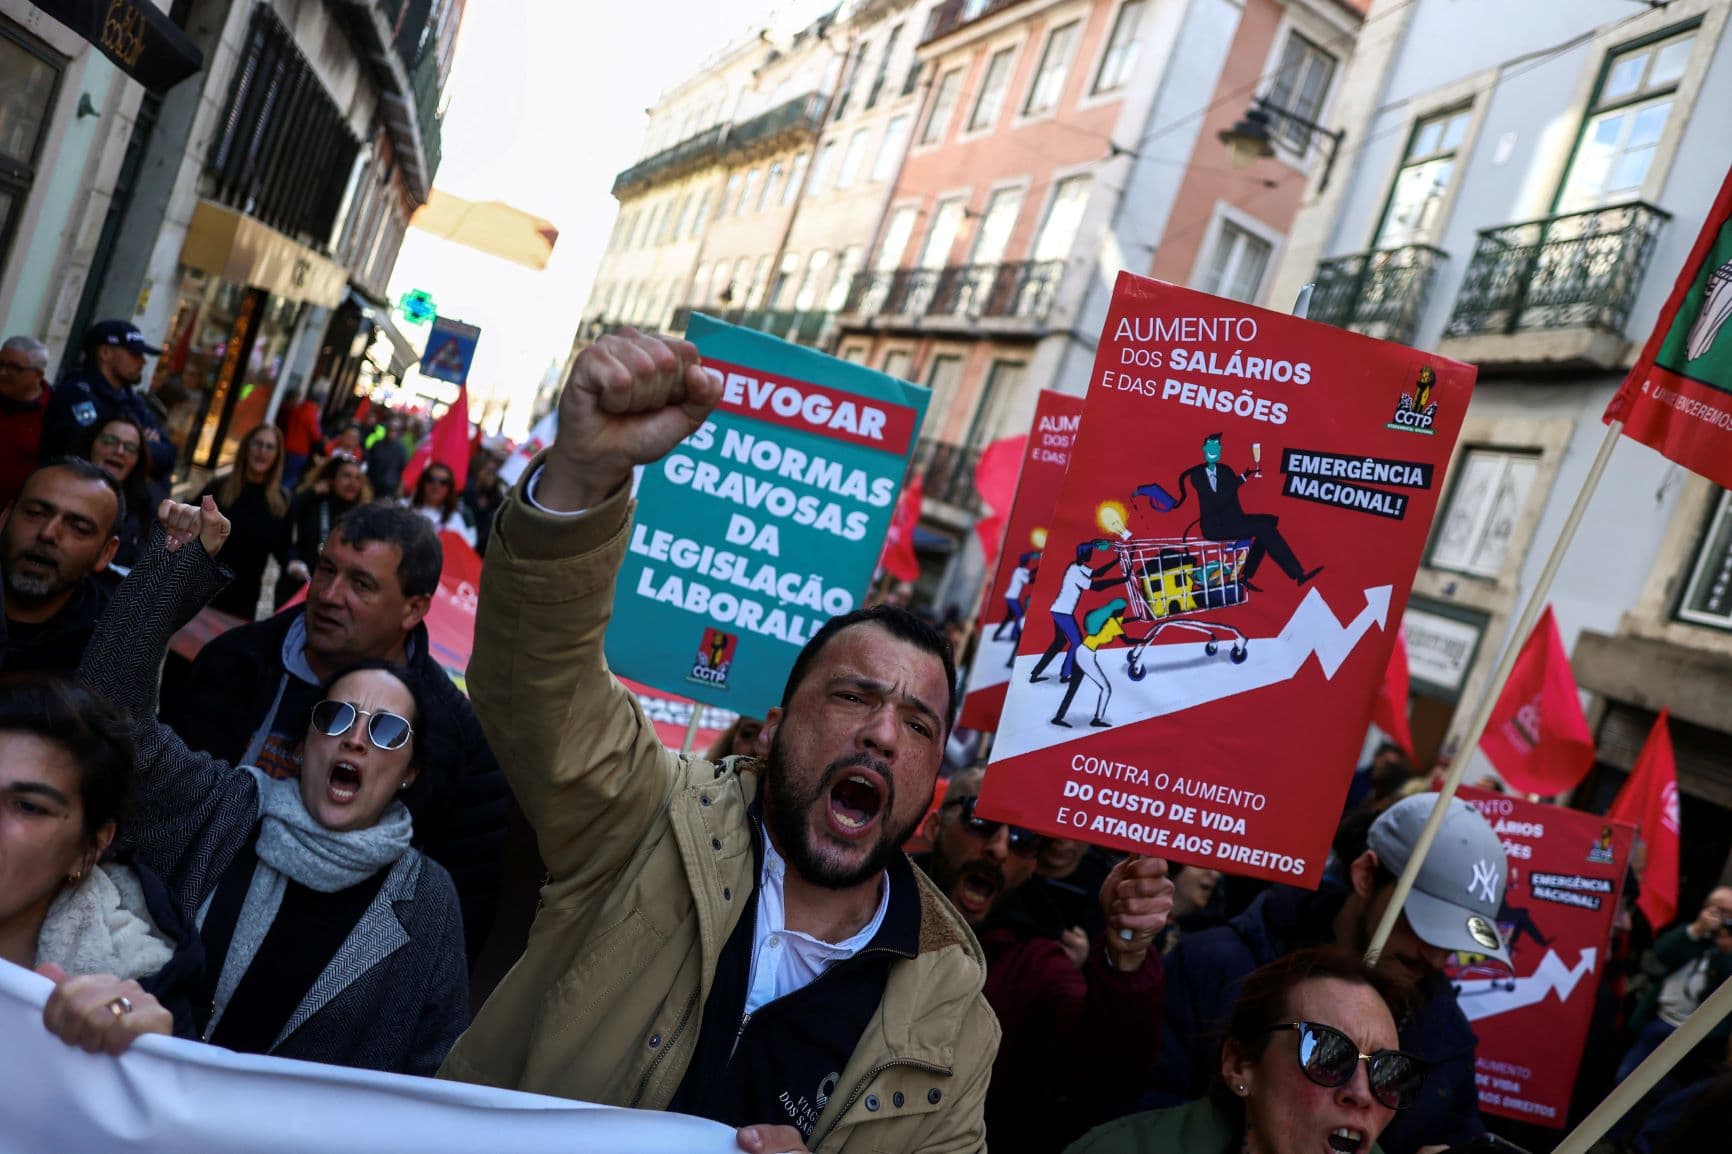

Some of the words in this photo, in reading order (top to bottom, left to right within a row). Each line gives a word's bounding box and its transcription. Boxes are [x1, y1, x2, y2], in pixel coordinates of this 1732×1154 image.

[1114, 317, 1257, 341] AUMENTO
[1121, 348, 1162, 367] DOS
[1170, 349, 1312, 385] SALÁRIOS
[1102, 371, 1115, 388] E
[1117, 374, 1157, 396] DAS
[1162, 378, 1289, 425] PENSÕES
[1039, 415, 1082, 431] AUM
[1395, 409, 1433, 428] CGTP
[1032, 448, 1040, 459] E
[1042, 450, 1066, 465] DAS
[1043, 434, 1069, 447] DOS
[720, 428, 895, 507] NORMAS
[1288, 454, 1423, 486] EMERGÊNCIA
[664, 454, 870, 541] GRAVOSAS
[1290, 476, 1403, 515] NACIONAL!
[725, 513, 780, 557] DA
[629, 523, 854, 616] LEGISLAÇÃO
[693, 665, 725, 683] CGTP
[1071, 754, 1149, 786] CONTRA
[1155, 773, 1169, 790] O
[1172, 777, 1266, 811] AUMENTO
[1064, 780, 1094, 801] DO
[1097, 788, 1165, 817] CUSTO
[1168, 804, 1197, 825] DE
[1201, 811, 1246, 835] VIDA
[1056, 806, 1070, 824] E
[1073, 811, 1088, 827] O
[1090, 815, 1171, 847] ATAQUE
[1171, 833, 1213, 856] AOS
[1216, 842, 1306, 875] DIREITOS
[1467, 859, 1500, 904] NY
[779, 1090, 799, 1117] DOS
[797, 1096, 819, 1122] VIAG
